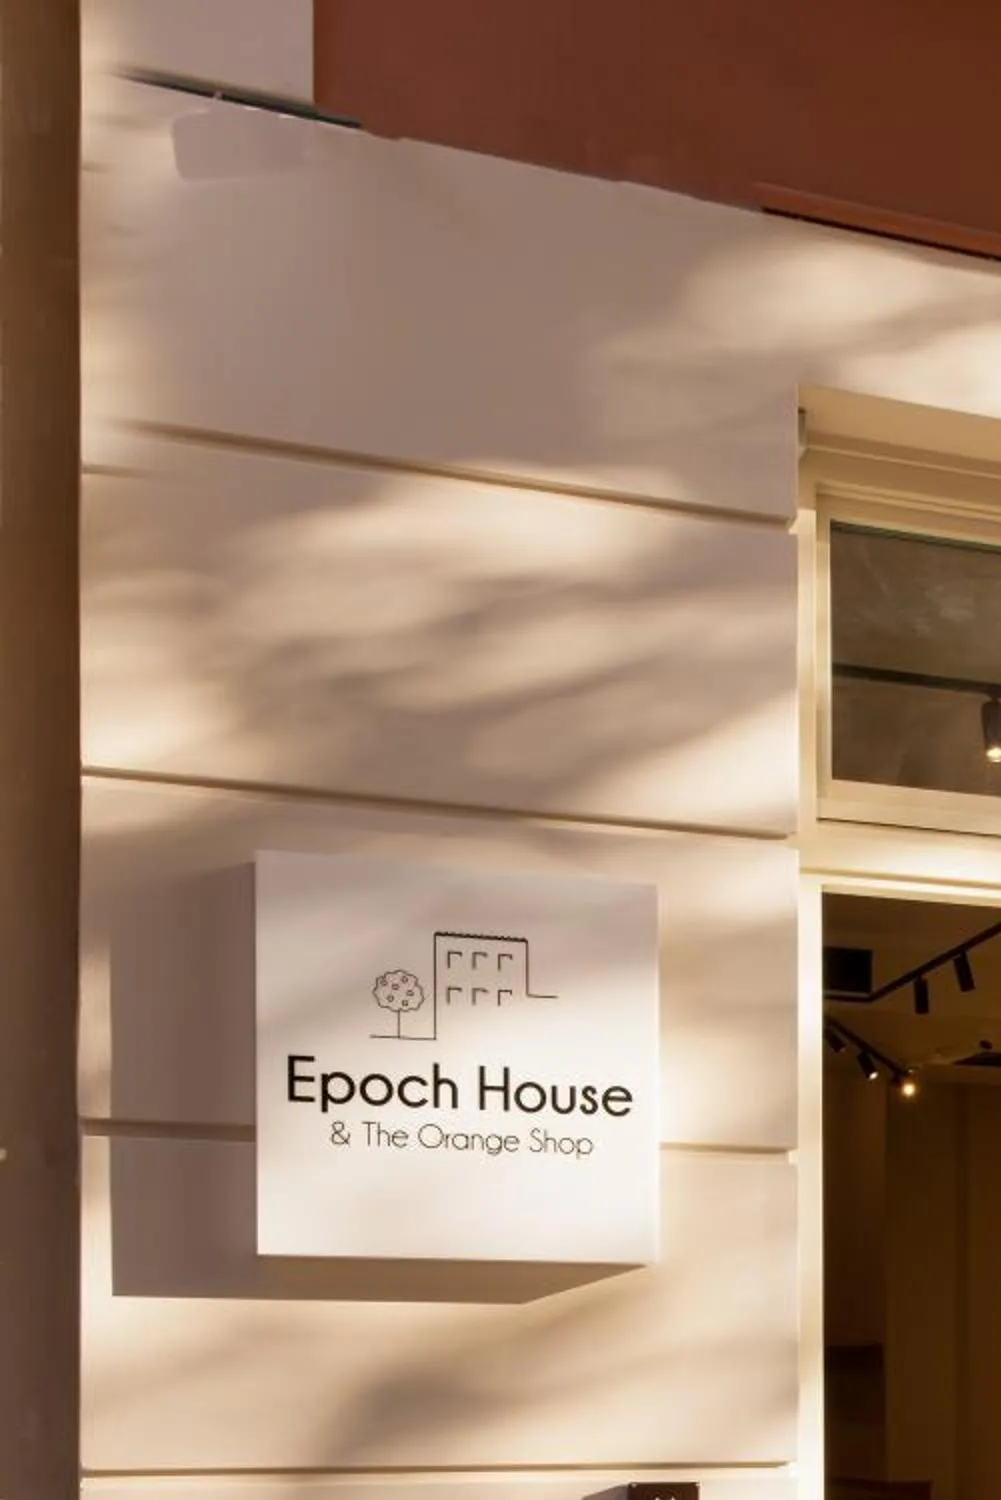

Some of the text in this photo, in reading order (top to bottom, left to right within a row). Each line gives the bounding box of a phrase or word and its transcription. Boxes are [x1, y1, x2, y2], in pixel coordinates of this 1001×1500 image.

[287, 1054, 633, 1117] Epoch House
[330, 1121, 594, 1159] & The Orange Shop
